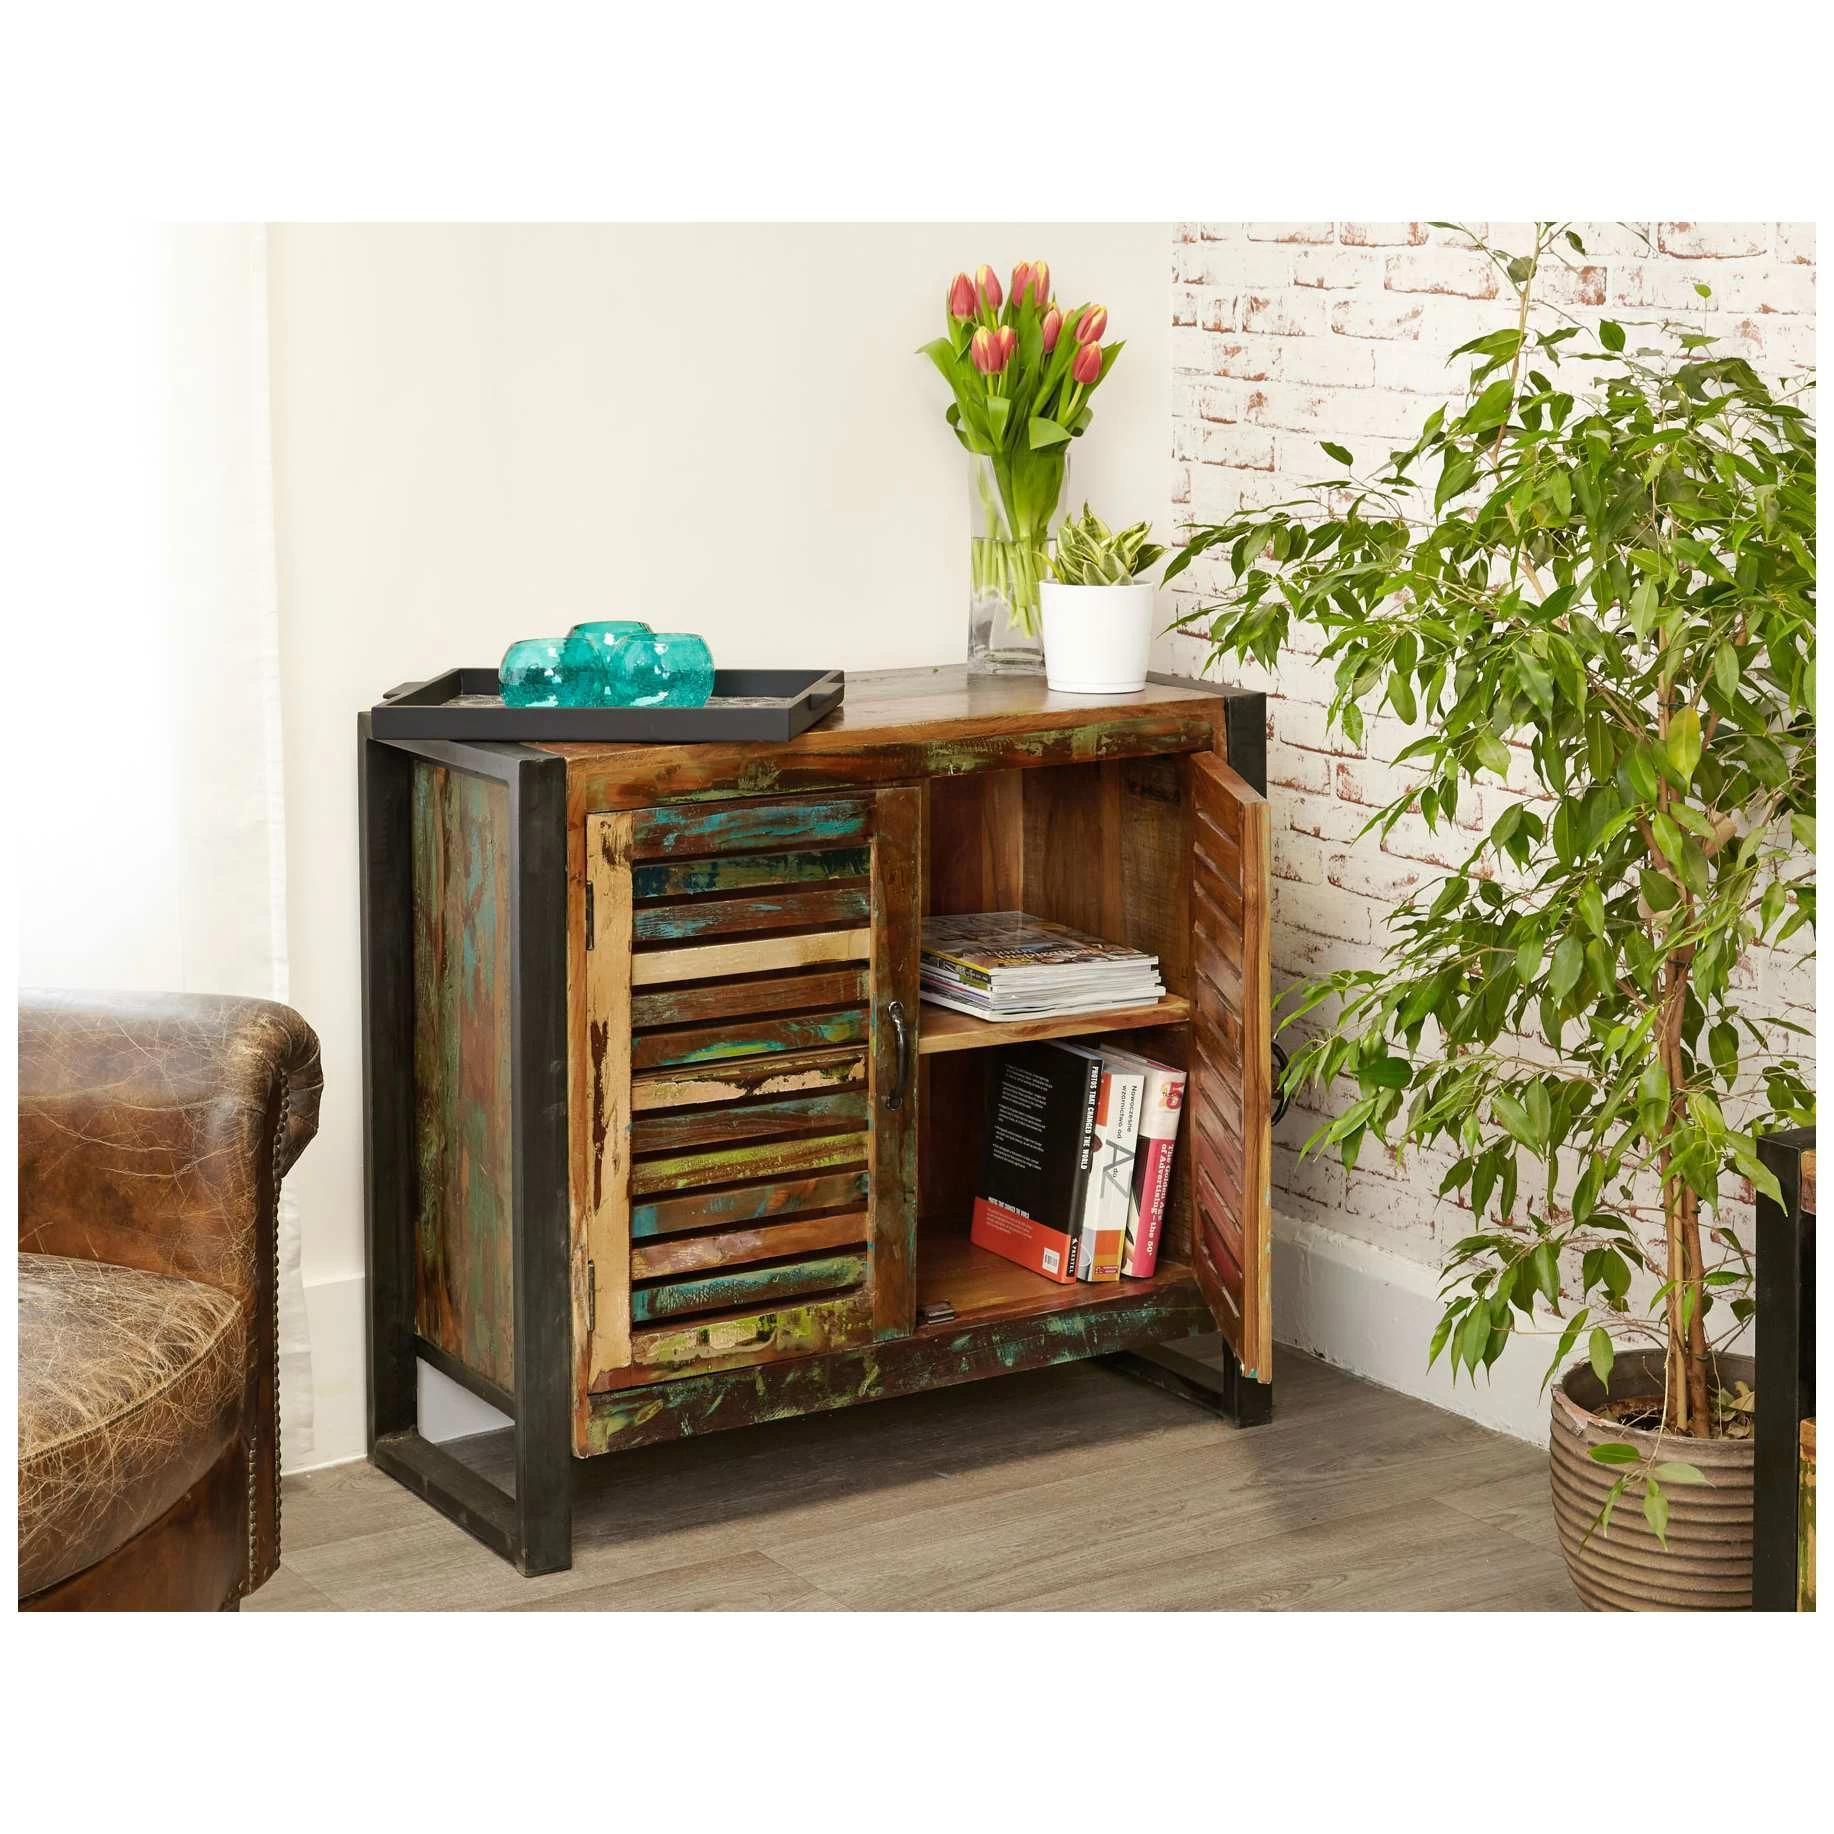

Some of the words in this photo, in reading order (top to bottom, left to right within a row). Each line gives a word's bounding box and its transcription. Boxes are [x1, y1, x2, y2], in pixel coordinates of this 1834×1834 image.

[1090, 1066, 1099, 1089] PHOTOS
[1088, 1091, 1097, 1105] THAT
[1118, 1085, 1127, 1127] wzornictwo
[1127, 1085, 1137, 1132] Nowoczesne
[1085, 1107, 1095, 1134] CHANGED
[1083, 1136, 1091, 1147] THE
[1161, 1144, 1168, 1154] of
[1080, 1149, 1089, 1170] WORLD
[1103, 1139, 1135, 1172] A
[1149, 1222, 1157, 1238] the
